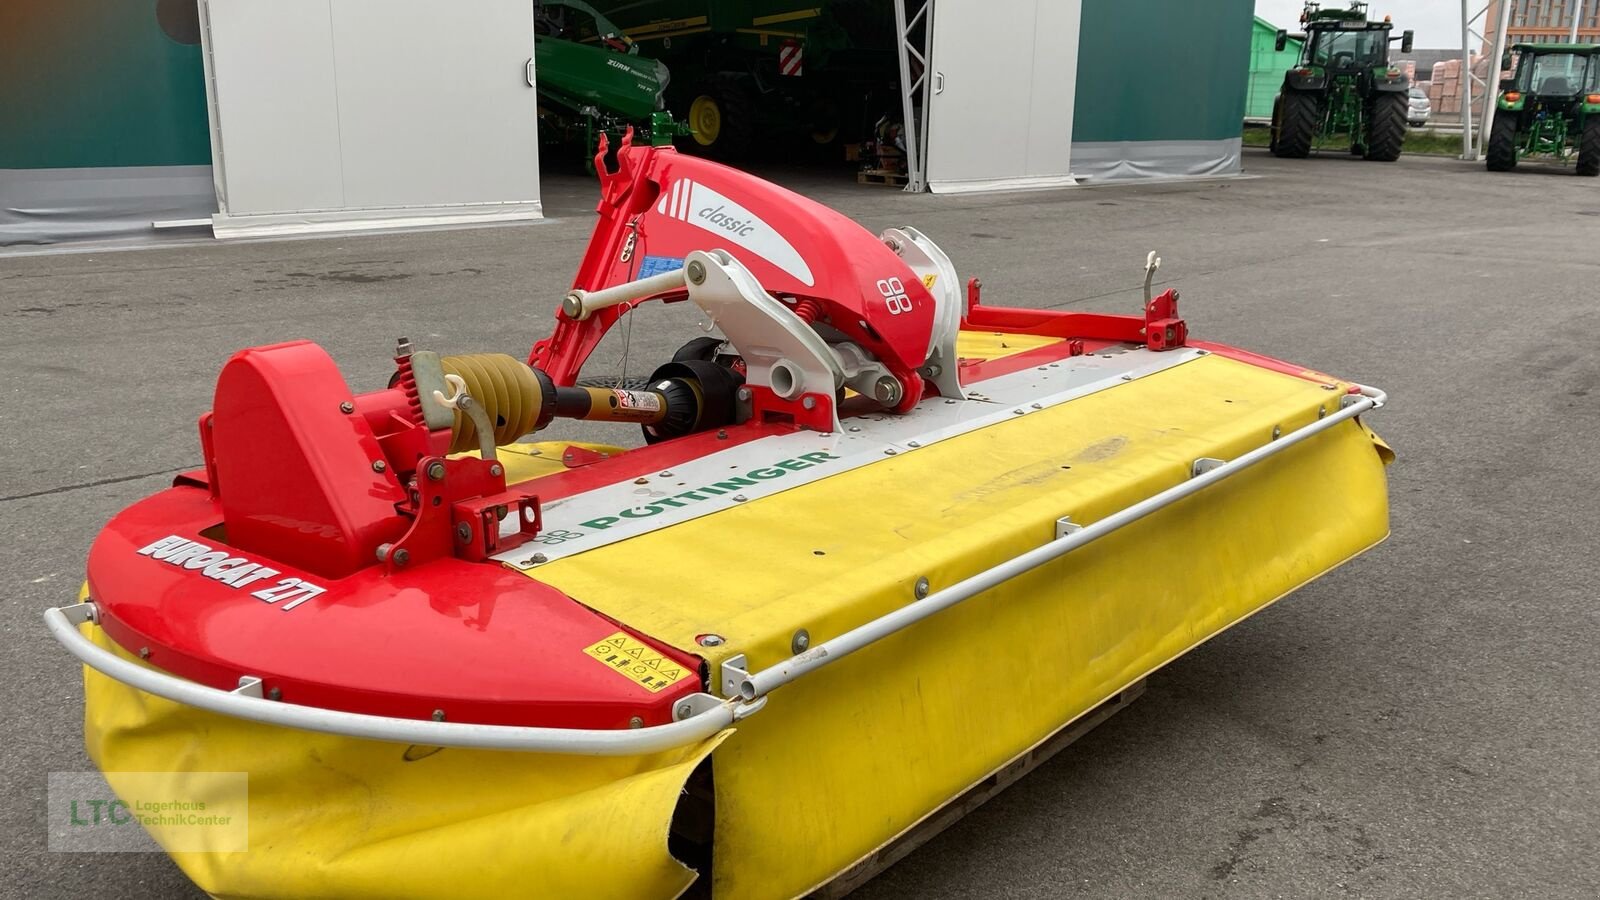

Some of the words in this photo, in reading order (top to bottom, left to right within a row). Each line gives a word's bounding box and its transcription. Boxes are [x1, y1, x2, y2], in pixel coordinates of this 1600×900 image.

[698, 205, 754, 237] classic
[136, 534, 282, 589] EUROCAT
[250, 577, 328, 611] 271
